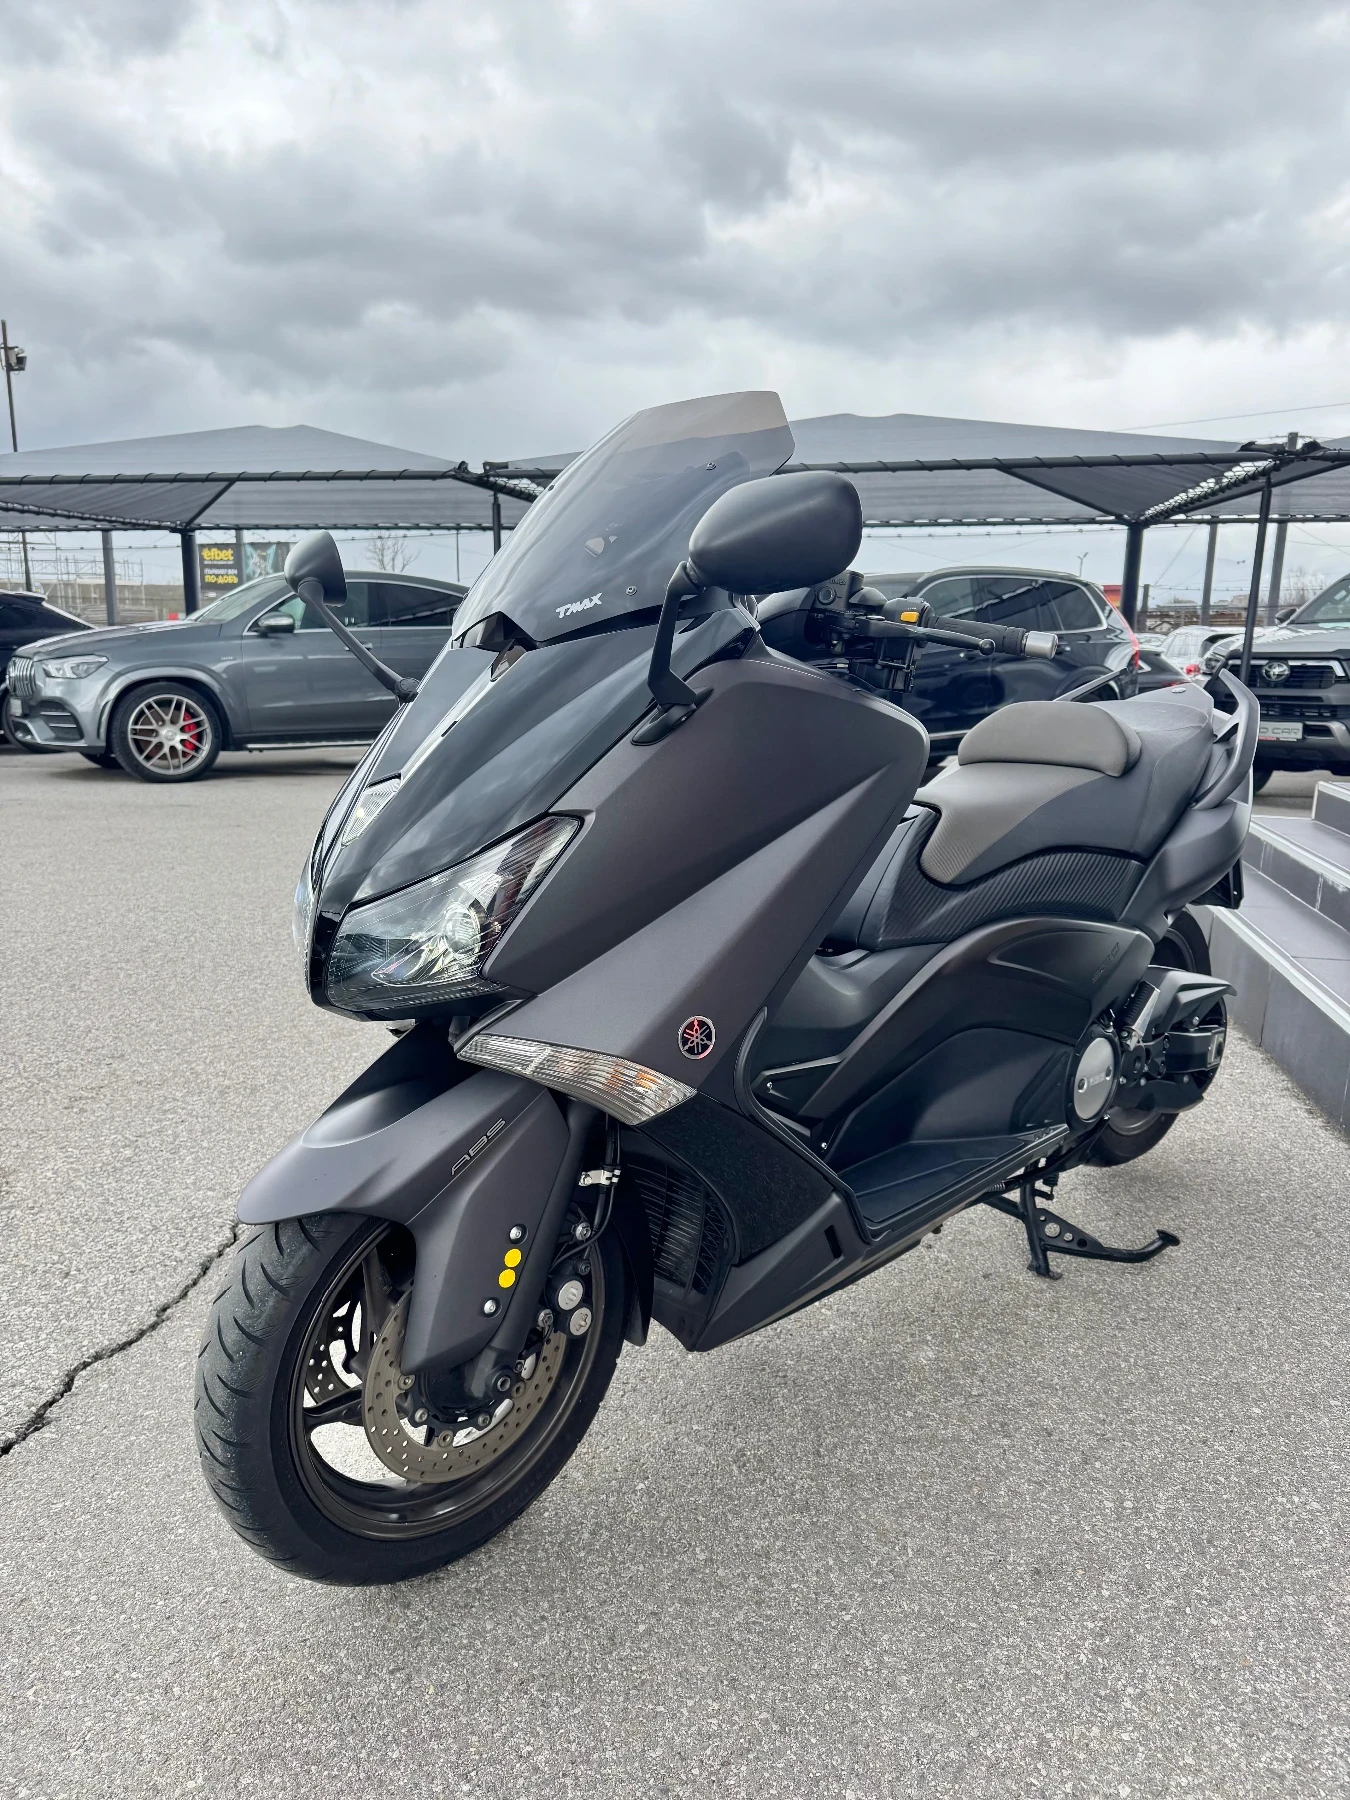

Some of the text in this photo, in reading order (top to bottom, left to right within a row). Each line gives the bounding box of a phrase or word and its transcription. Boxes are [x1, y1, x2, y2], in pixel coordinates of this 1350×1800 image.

[201, 548, 234, 560] efbet
[555, 592, 603, 618] TMAX
[1272, 727, 1300, 735] CAR
[451, 1117, 506, 1176] ABS
